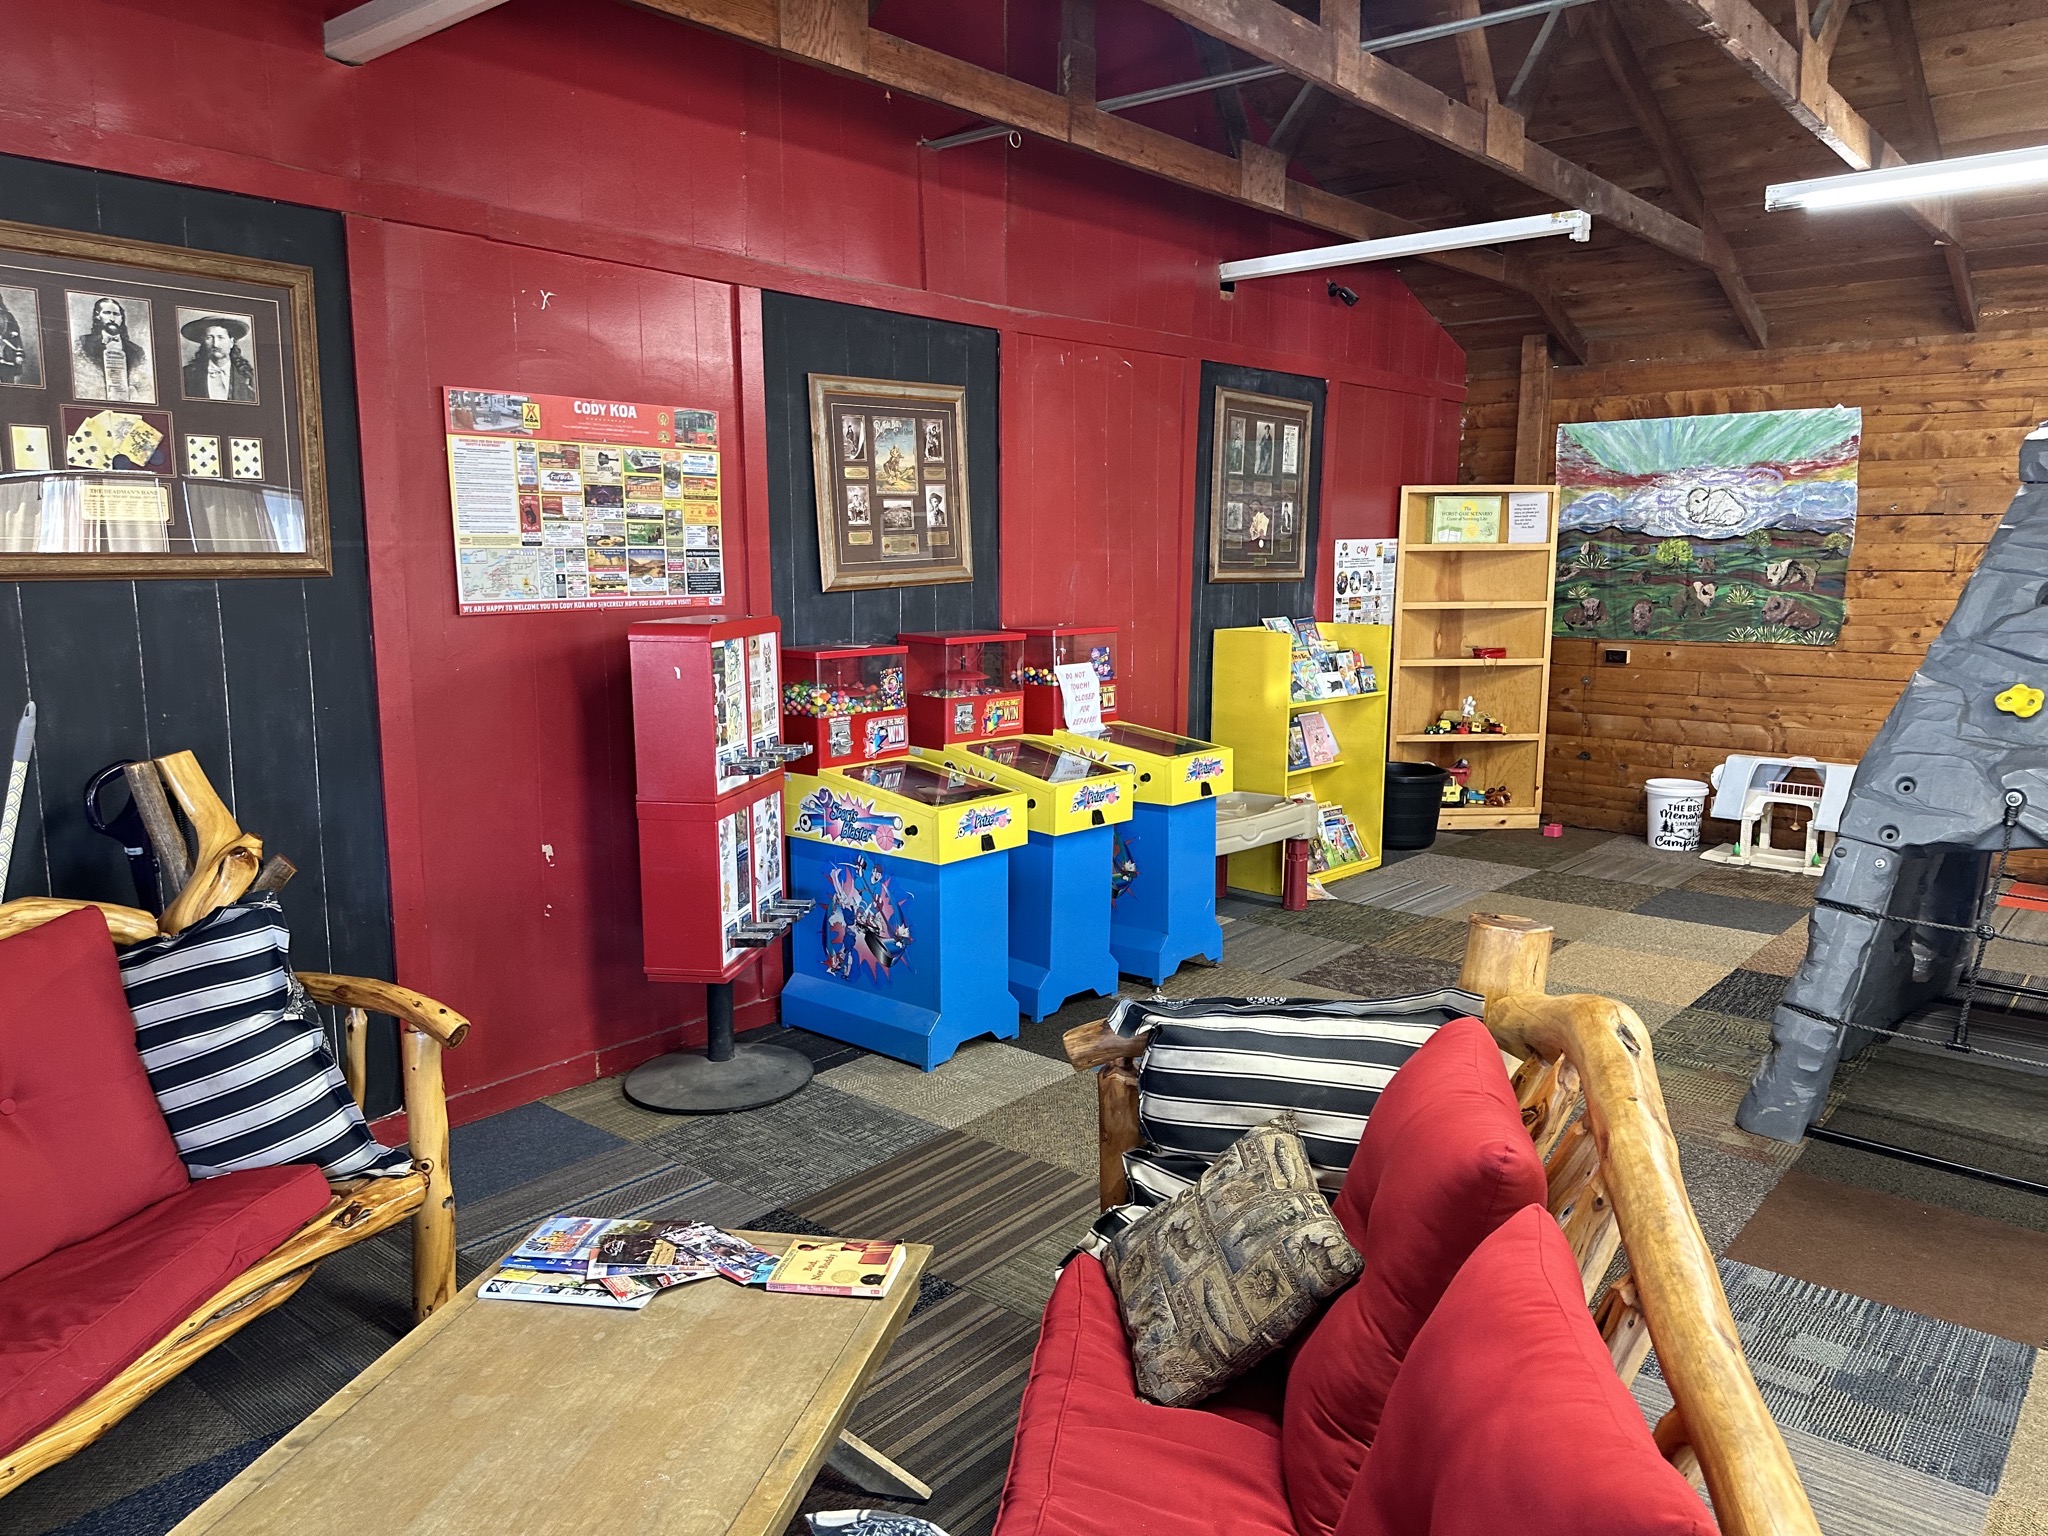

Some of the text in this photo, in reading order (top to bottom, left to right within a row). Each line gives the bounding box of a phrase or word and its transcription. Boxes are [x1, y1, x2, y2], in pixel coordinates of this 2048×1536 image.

[573, 400, 638, 418] CODY KOA
[1071, 681, 1090, 690] TOUCH!
[1075, 692, 1095, 702] CLOSED
[1102, 692, 1115, 708] WIN
[1004, 706, 1019, 721] WIN
[888, 725, 905, 744] WIN
[1087, 790, 1106, 804] Prize
[829, 802, 859, 823] Sports
[1668, 804, 1685, 812] THE
[974, 813, 995, 829] Prize
[841, 822, 872, 842] Blaster
[1654, 836, 1700, 852] Campin
[803, 1260, 819, 1272] Bud,
[811, 1254, 838, 1281] Not Buddy
